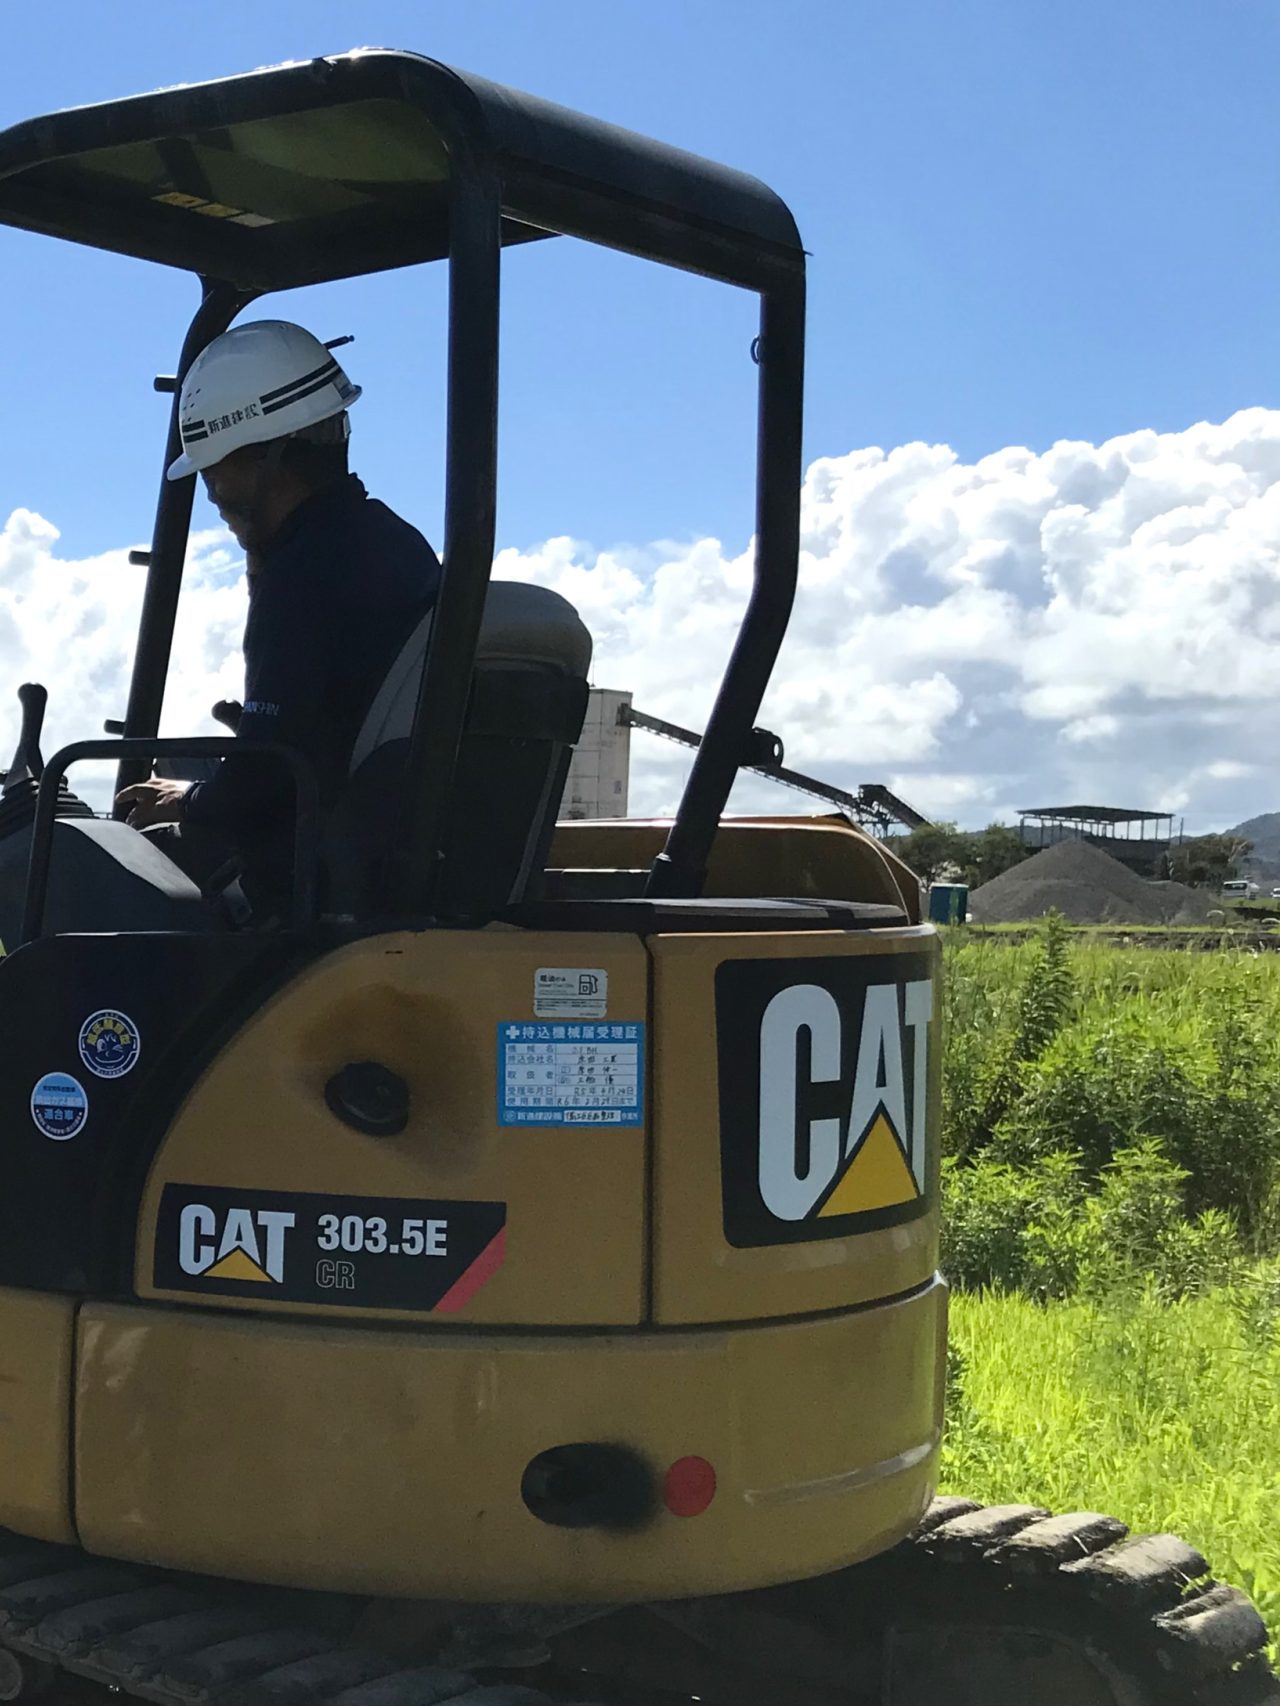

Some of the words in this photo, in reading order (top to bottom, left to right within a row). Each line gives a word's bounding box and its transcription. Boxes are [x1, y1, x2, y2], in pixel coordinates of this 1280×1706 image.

[758, 979, 933, 1222] CAT
[179, 1203, 296, 1284] CAT
[317, 1214, 447, 1257] 303.5E
[315, 1259, 355, 1290] CR
